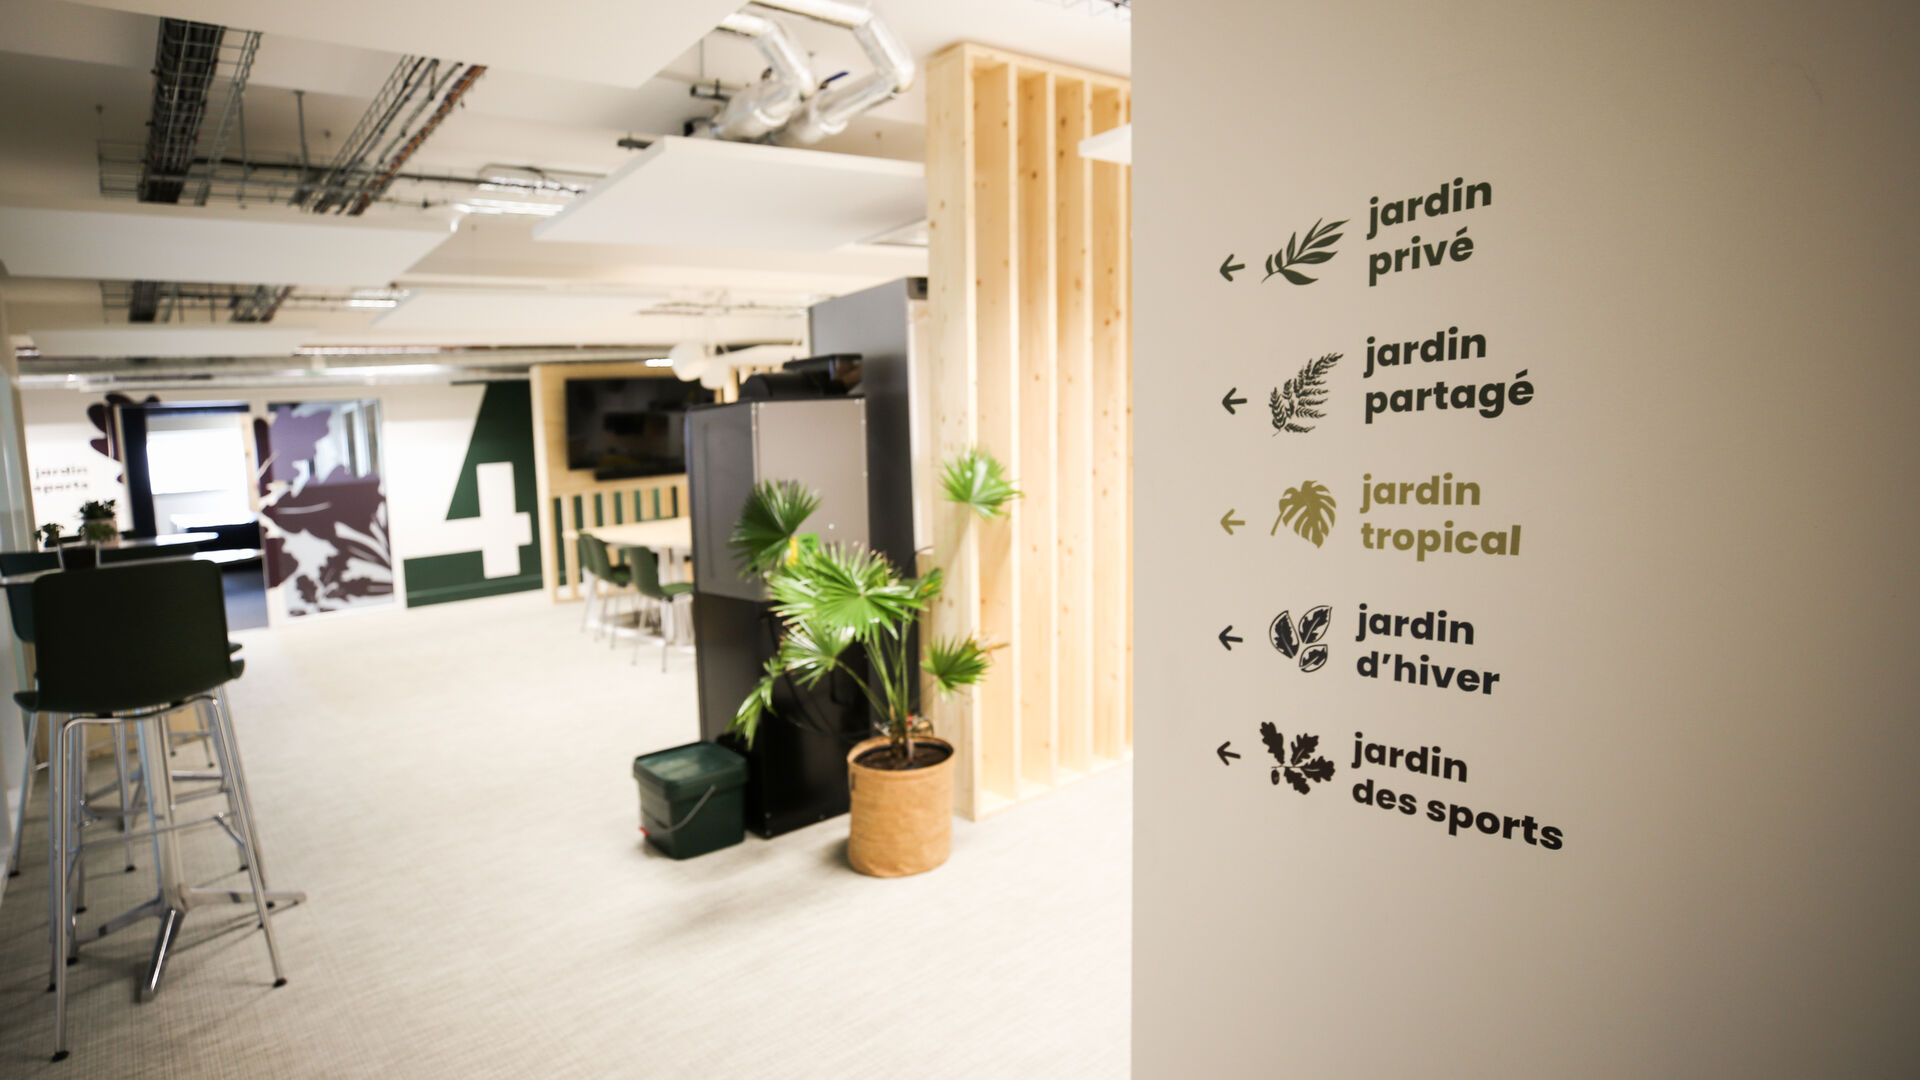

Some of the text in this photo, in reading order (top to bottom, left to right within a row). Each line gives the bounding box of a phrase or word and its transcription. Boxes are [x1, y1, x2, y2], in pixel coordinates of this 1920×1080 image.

[1366, 177, 1493, 240] jardin
[1368, 226, 1475, 287] privé
[1363, 326, 1487, 379] jardin
[1364, 369, 1535, 425] partagé
[1359, 472, 1481, 514] jardin
[1360, 520, 1522, 562] tropical
[1355, 603, 1475, 645] jardin
[1356, 651, 1501, 695] d’hiver
[1350, 731, 1468, 783] jardin
[1351, 778, 1564, 851] des sports
